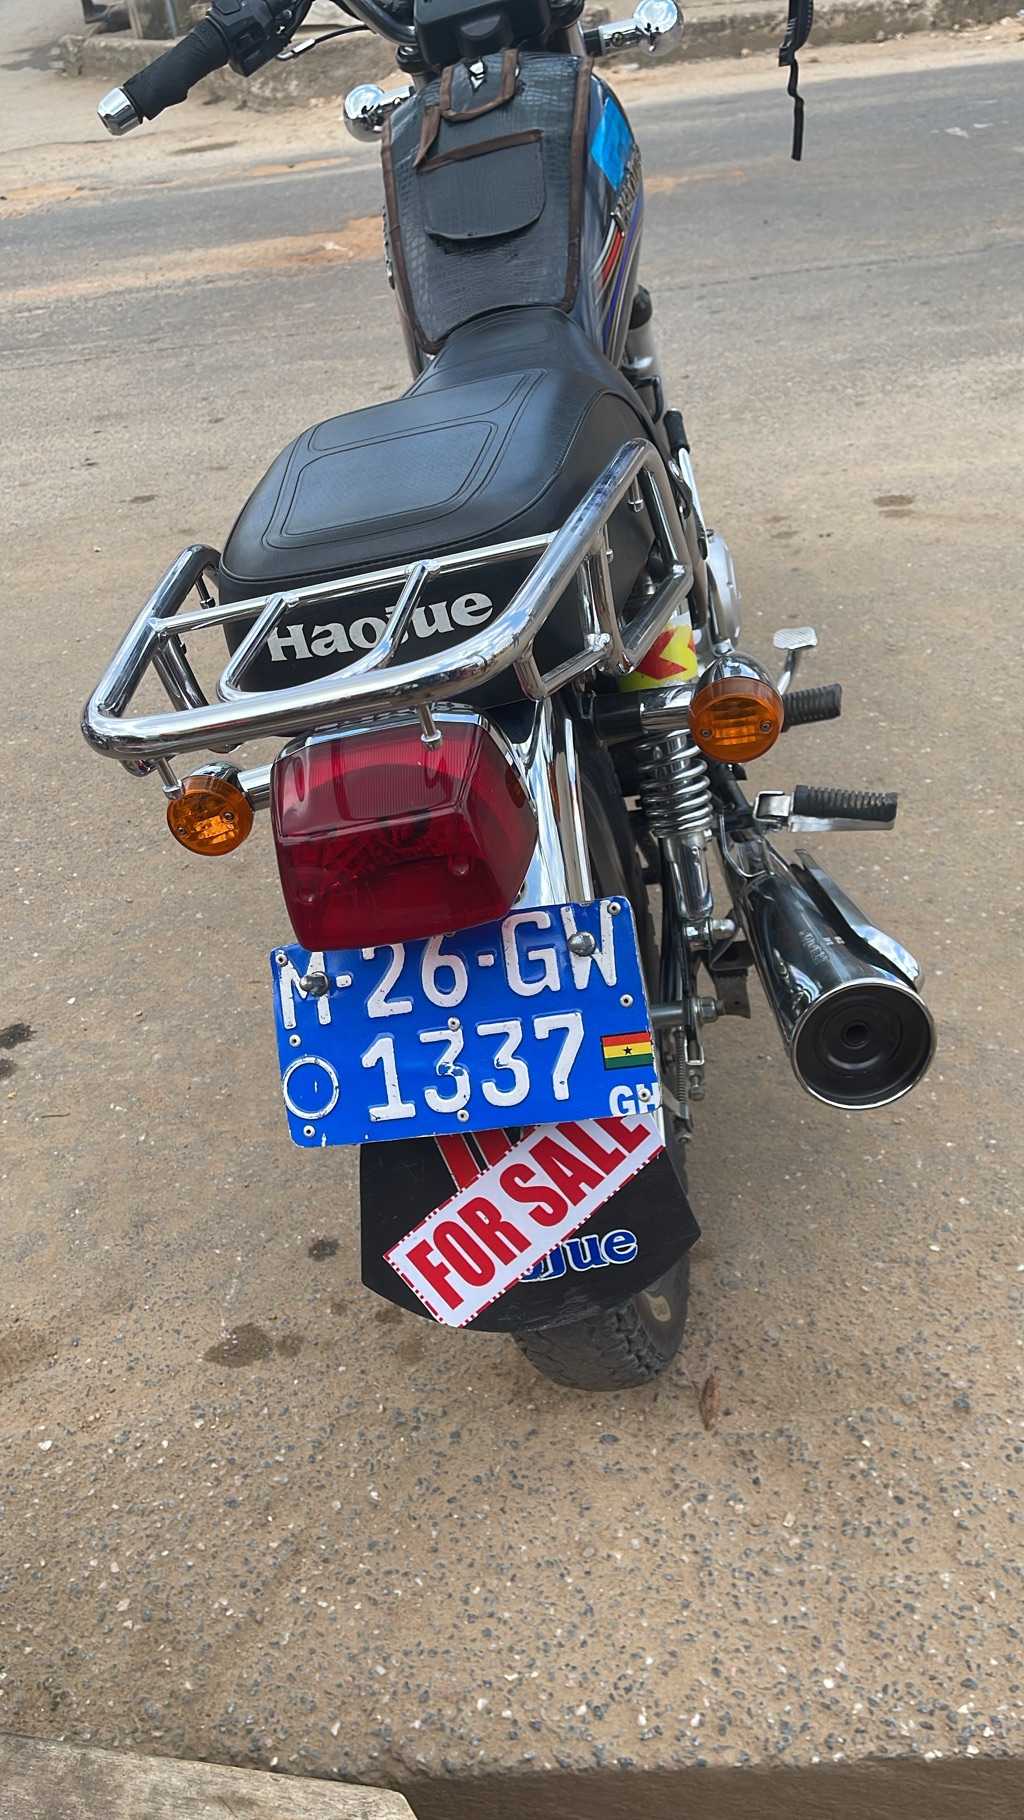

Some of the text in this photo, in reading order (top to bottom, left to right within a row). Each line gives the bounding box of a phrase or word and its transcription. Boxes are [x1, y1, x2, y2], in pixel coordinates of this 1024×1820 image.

[266, 592, 493, 662] Haoue
[279, 900, 618, 1030] M-26-GW
[361, 1010, 585, 1123] 1337
[609, 1082, 661, 1117] GH
[404, 1197, 533, 1311] FOR
